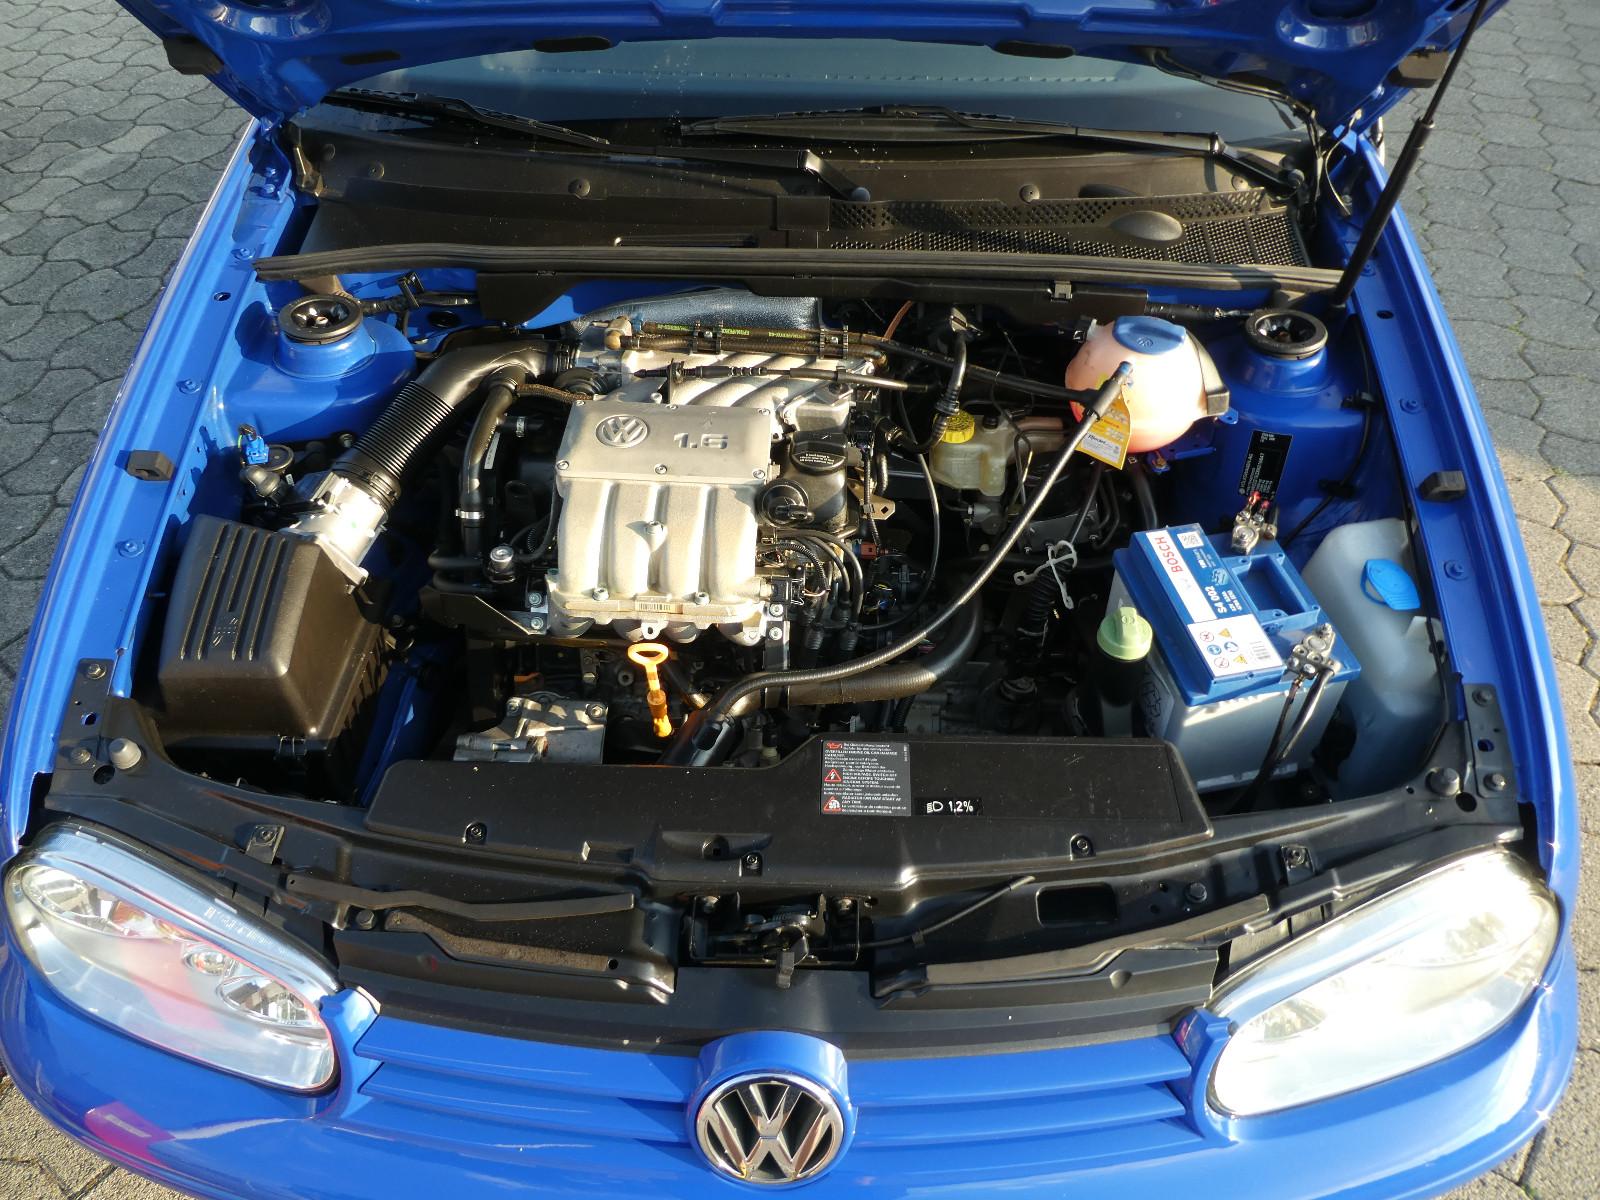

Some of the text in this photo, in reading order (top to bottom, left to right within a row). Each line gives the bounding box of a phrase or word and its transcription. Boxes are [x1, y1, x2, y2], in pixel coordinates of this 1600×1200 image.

[597, 415, 648, 447] VW
[673, 432, 728, 449] 1.6
[1154, 536, 1184, 572] BOSCH
[1204, 586, 1220, 601] 002
[1213, 602, 1227, 613] S4
[701, 1078, 839, 1182] VW
